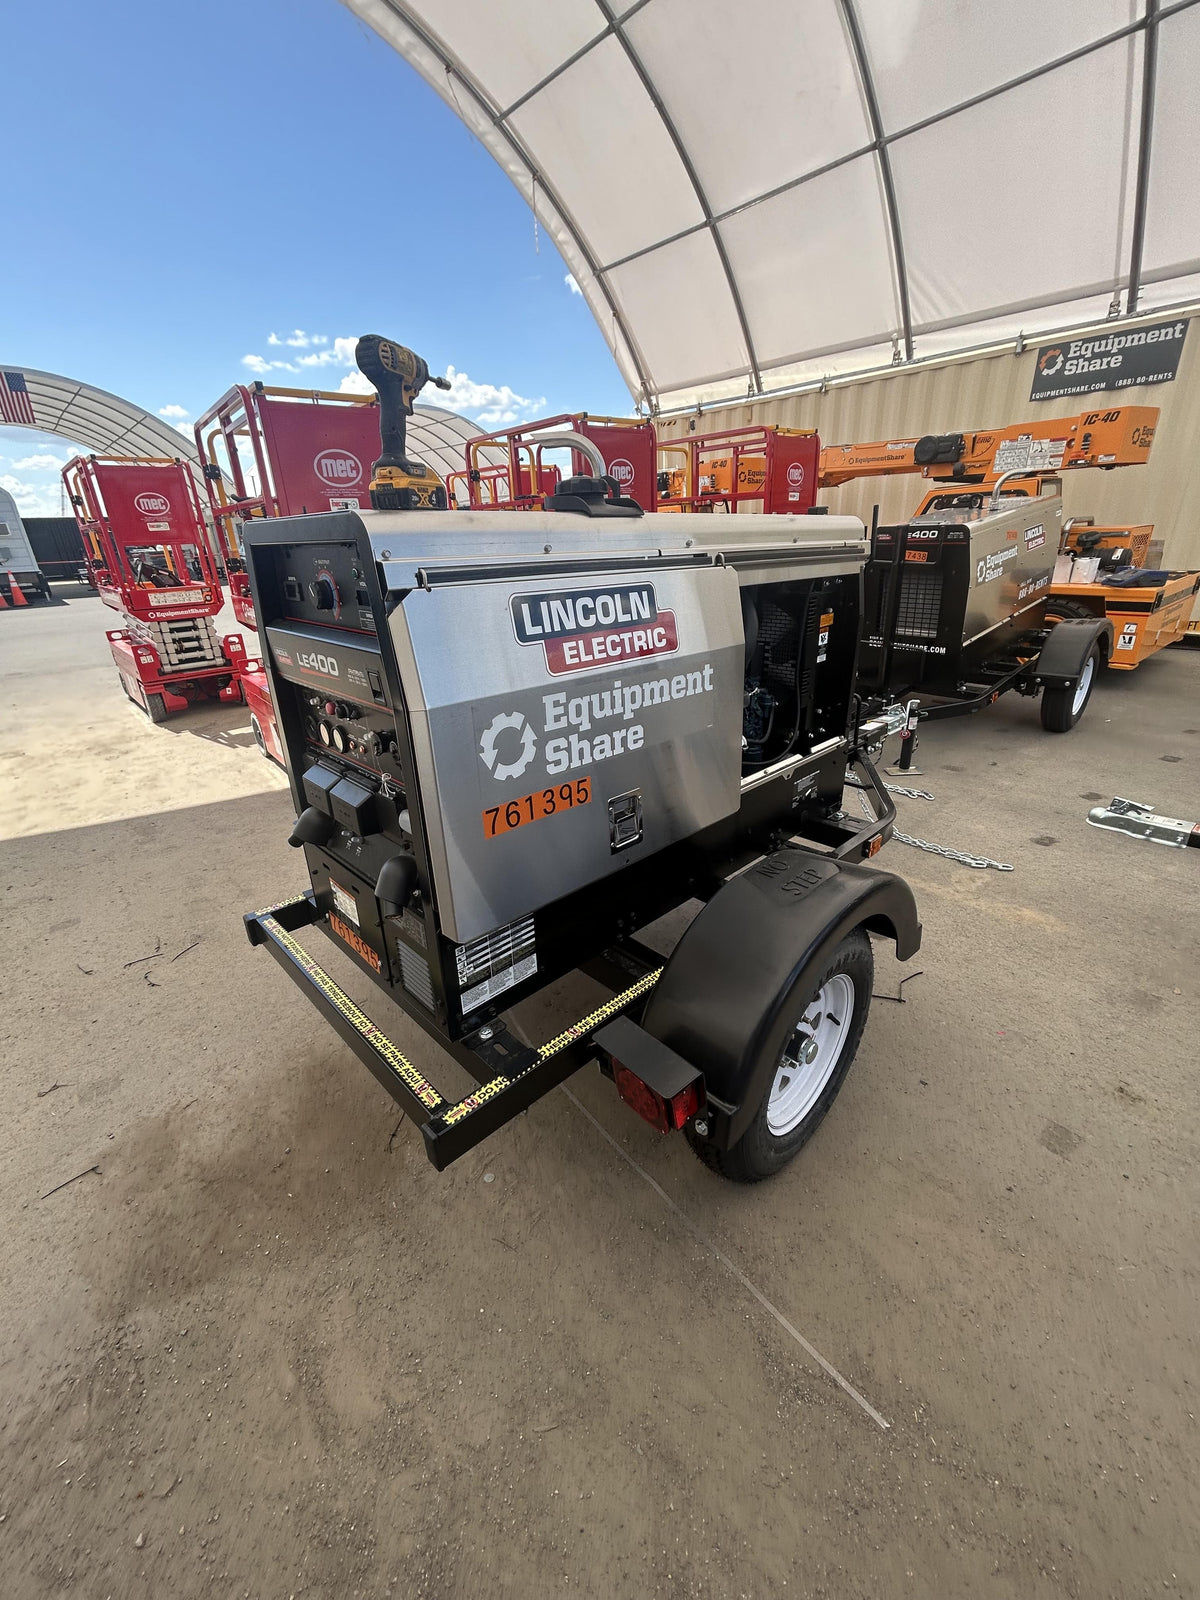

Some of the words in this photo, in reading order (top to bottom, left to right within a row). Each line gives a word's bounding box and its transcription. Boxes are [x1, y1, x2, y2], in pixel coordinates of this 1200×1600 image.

[1068, 322, 1184, 358] Equipment
[1064, 355, 1122, 376] Share
[1115, 377, 1134, 387] (888)
[1136, 372, 1173, 384] 80-RENTS
[1031, 382, 1106, 400] EQUIPMENTSHARE.COM
[1083, 411, 1121, 425] IC-40
[321, 459, 357, 477] mec
[855, 454, 904, 464] EquipmentShare
[612, 466, 631, 480] mec
[139, 498, 166, 510] mec
[986, 545, 1018, 568] Equipment
[156, 608, 209, 618] EquipmentShare
[521, 590, 651, 636] LINCOLN
[562, 626, 667, 665] ELECTRIC
[296, 652, 339, 676] LE400
[542, 663, 714, 732] Equipment
[545, 724, 644, 775] Share
[485, 778, 589, 835] 761395
[756, 860, 788, 879] NO
[781, 868, 822, 896] STEP
[332, 918, 379, 970] 761395
[578, 1019, 591, 1030] NE
[591, 1008, 608, 1022] PAS
[606, 992, 632, 1011] TENEZ
[371, 1032, 383, 1045] NO
[380, 1041, 391, 1053] SE
[387, 1049, 406, 1069] PARE
[547, 1033, 571, 1052] HERE
[477, 1086, 494, 1100] DO
